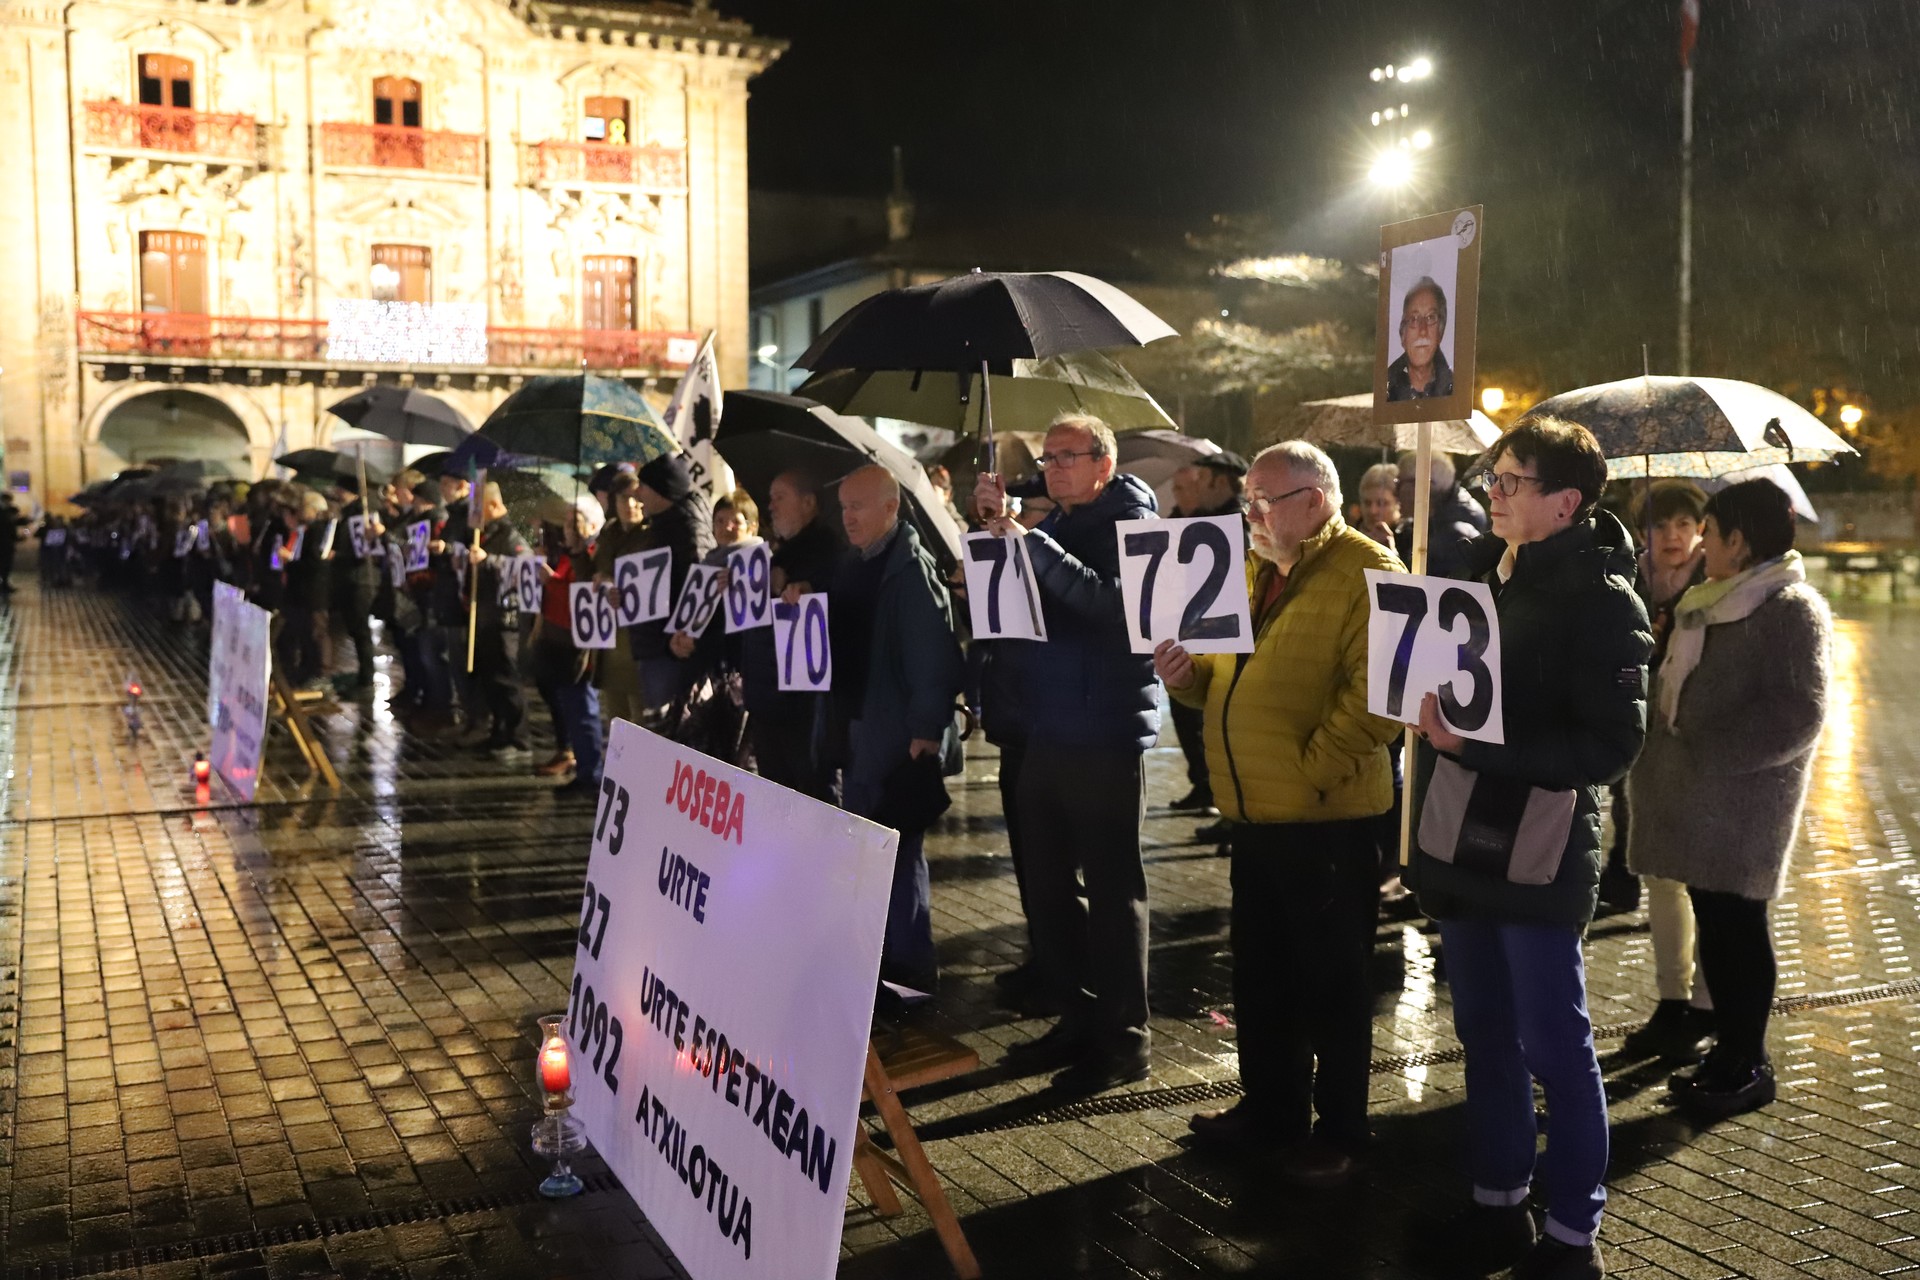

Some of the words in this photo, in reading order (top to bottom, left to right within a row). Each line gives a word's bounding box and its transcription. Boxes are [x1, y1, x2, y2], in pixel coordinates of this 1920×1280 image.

[574, 586, 613, 642] 66
[618, 552, 670, 623] 67
[675, 568, 720, 632] 68
[727, 547, 769, 627] 69
[969, 538, 1043, 637] 71
[1125, 521, 1240, 641] 72
[775, 598, 828, 686] 70
[1376, 582, 1494, 731] 73
[665, 759, 744, 845] JOSEBA
[598, 776, 630, 857] 73
[658, 846, 711, 925] URTE
[579, 880, 611, 962] 27
[639, 965, 690, 1053] URTE
[690, 1013, 837, 1194] ESPETXEAN
[570, 971, 623, 1096] 1992
[635, 1083, 753, 1261] ATXILOTUA
